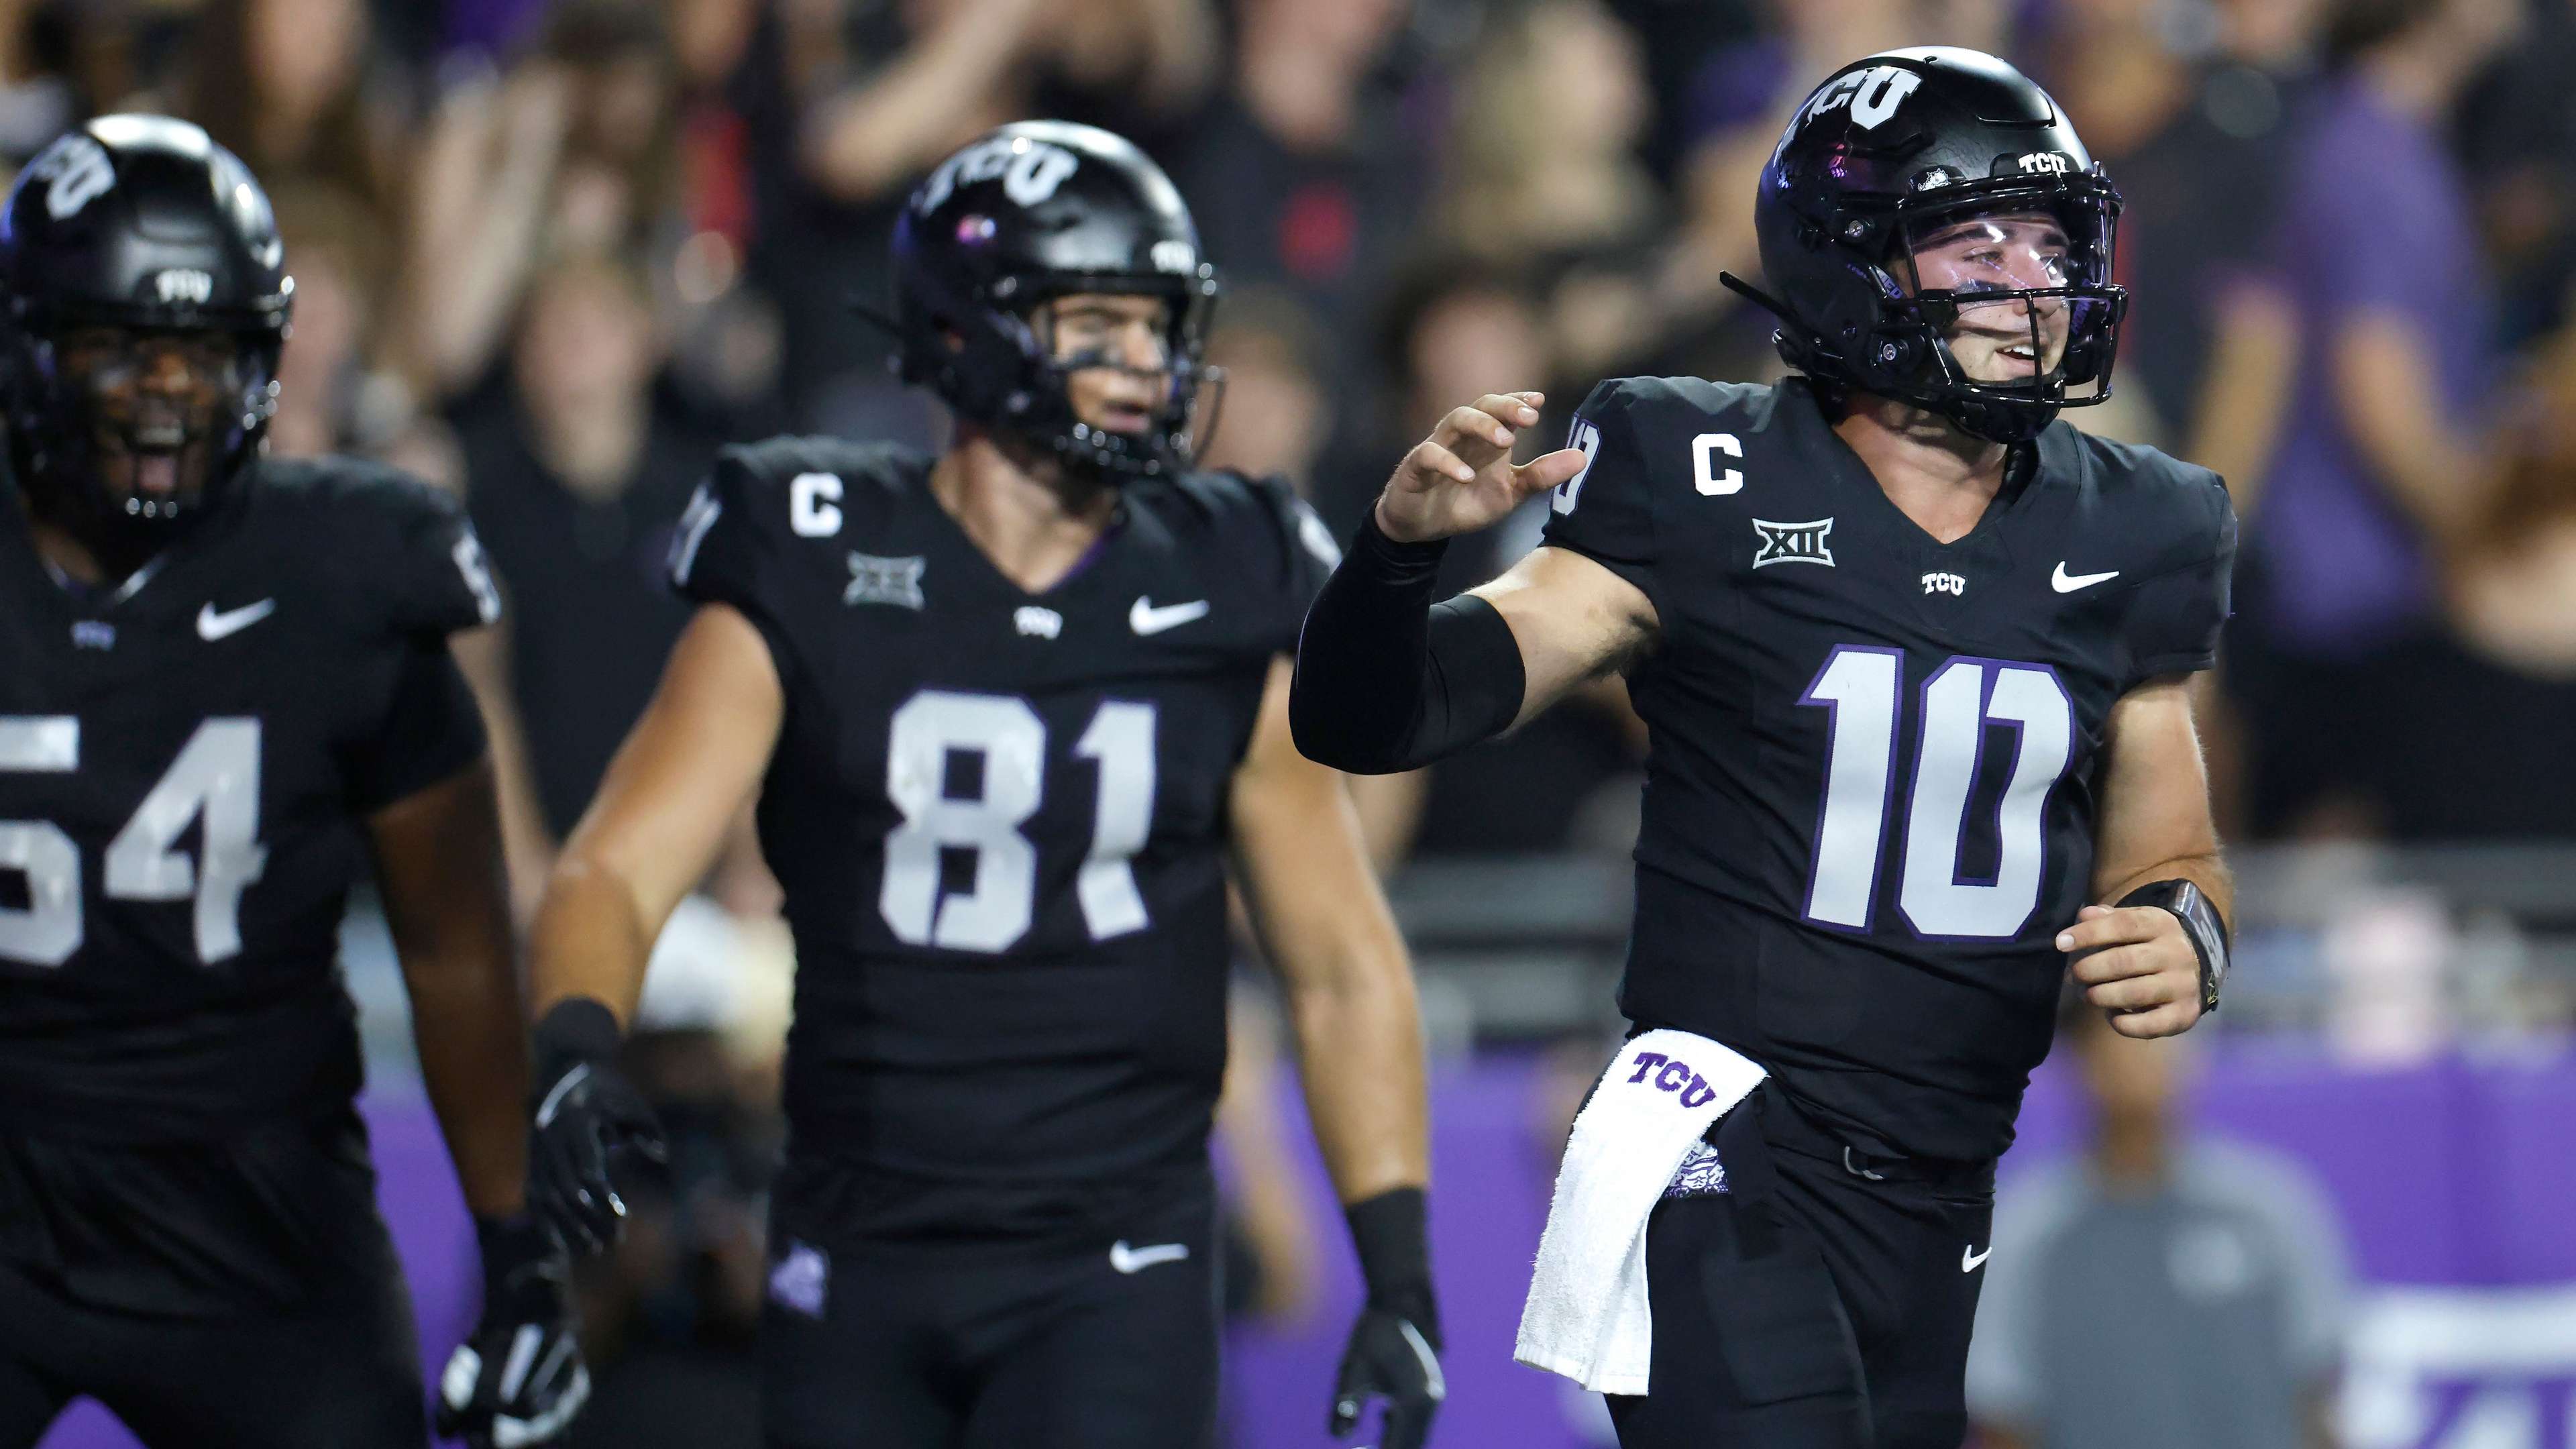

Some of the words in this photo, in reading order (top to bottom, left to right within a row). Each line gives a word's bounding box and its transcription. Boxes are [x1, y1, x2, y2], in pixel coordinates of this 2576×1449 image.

[2018, 152, 2067, 174] TCU
[1691, 432, 1744, 496] C
[790, 471, 845, 538] C
[1921, 571, 1966, 596] TCU
[879, 691, 1158, 954] 81
[1797, 643, 2076, 943] 10
[1626, 1051, 1717, 1109] TCU
